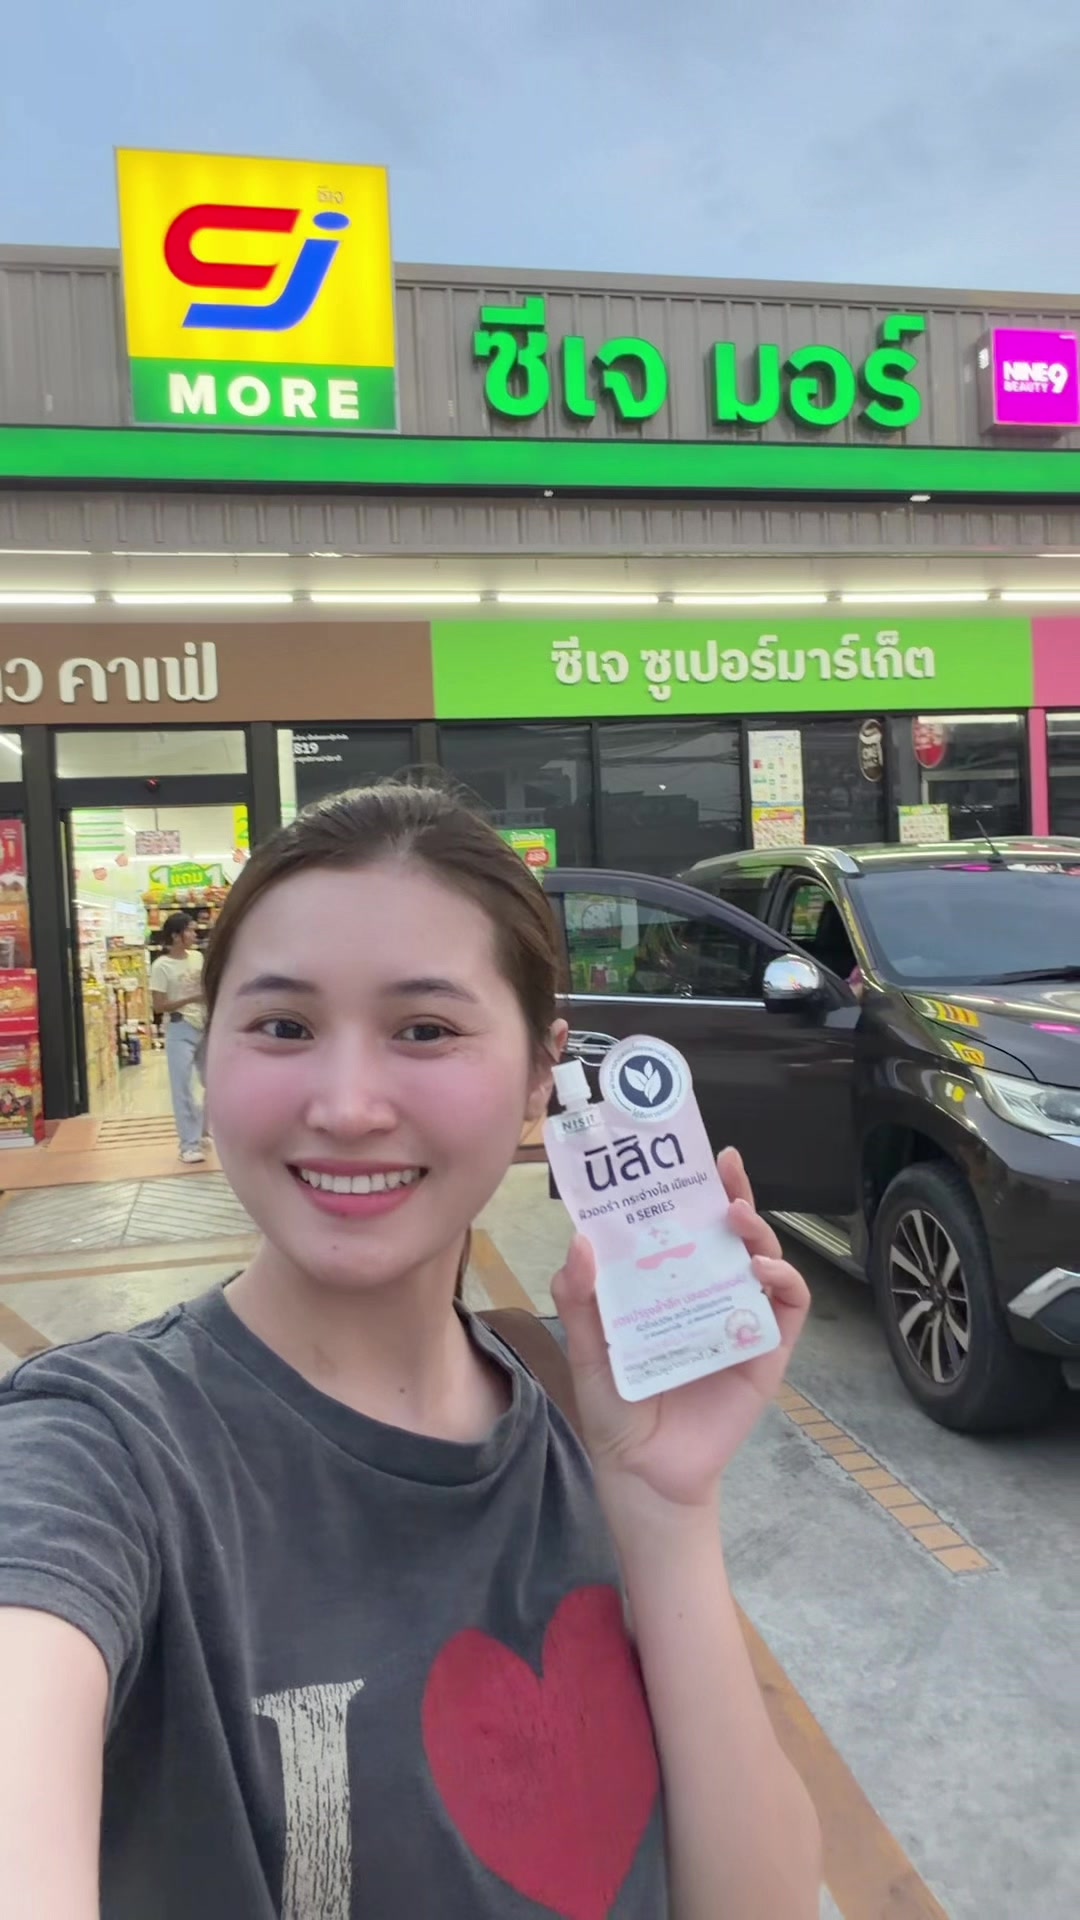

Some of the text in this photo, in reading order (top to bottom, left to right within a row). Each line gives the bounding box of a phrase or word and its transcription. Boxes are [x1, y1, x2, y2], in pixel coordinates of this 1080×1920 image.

[472, 297, 925, 429] ซีเจ มอร์
[1003, 380, 1049, 393] BEAUTY
[168, 373, 360, 420] MORE
[58, 641, 218, 704] คาเฟ่
[551, 630, 936, 701] ซีเจ ซูเปอร์มาร์เก็ต
[584, 1132, 685, 1192] นิสิต
[636, 1200, 675, 1222] SERIES
